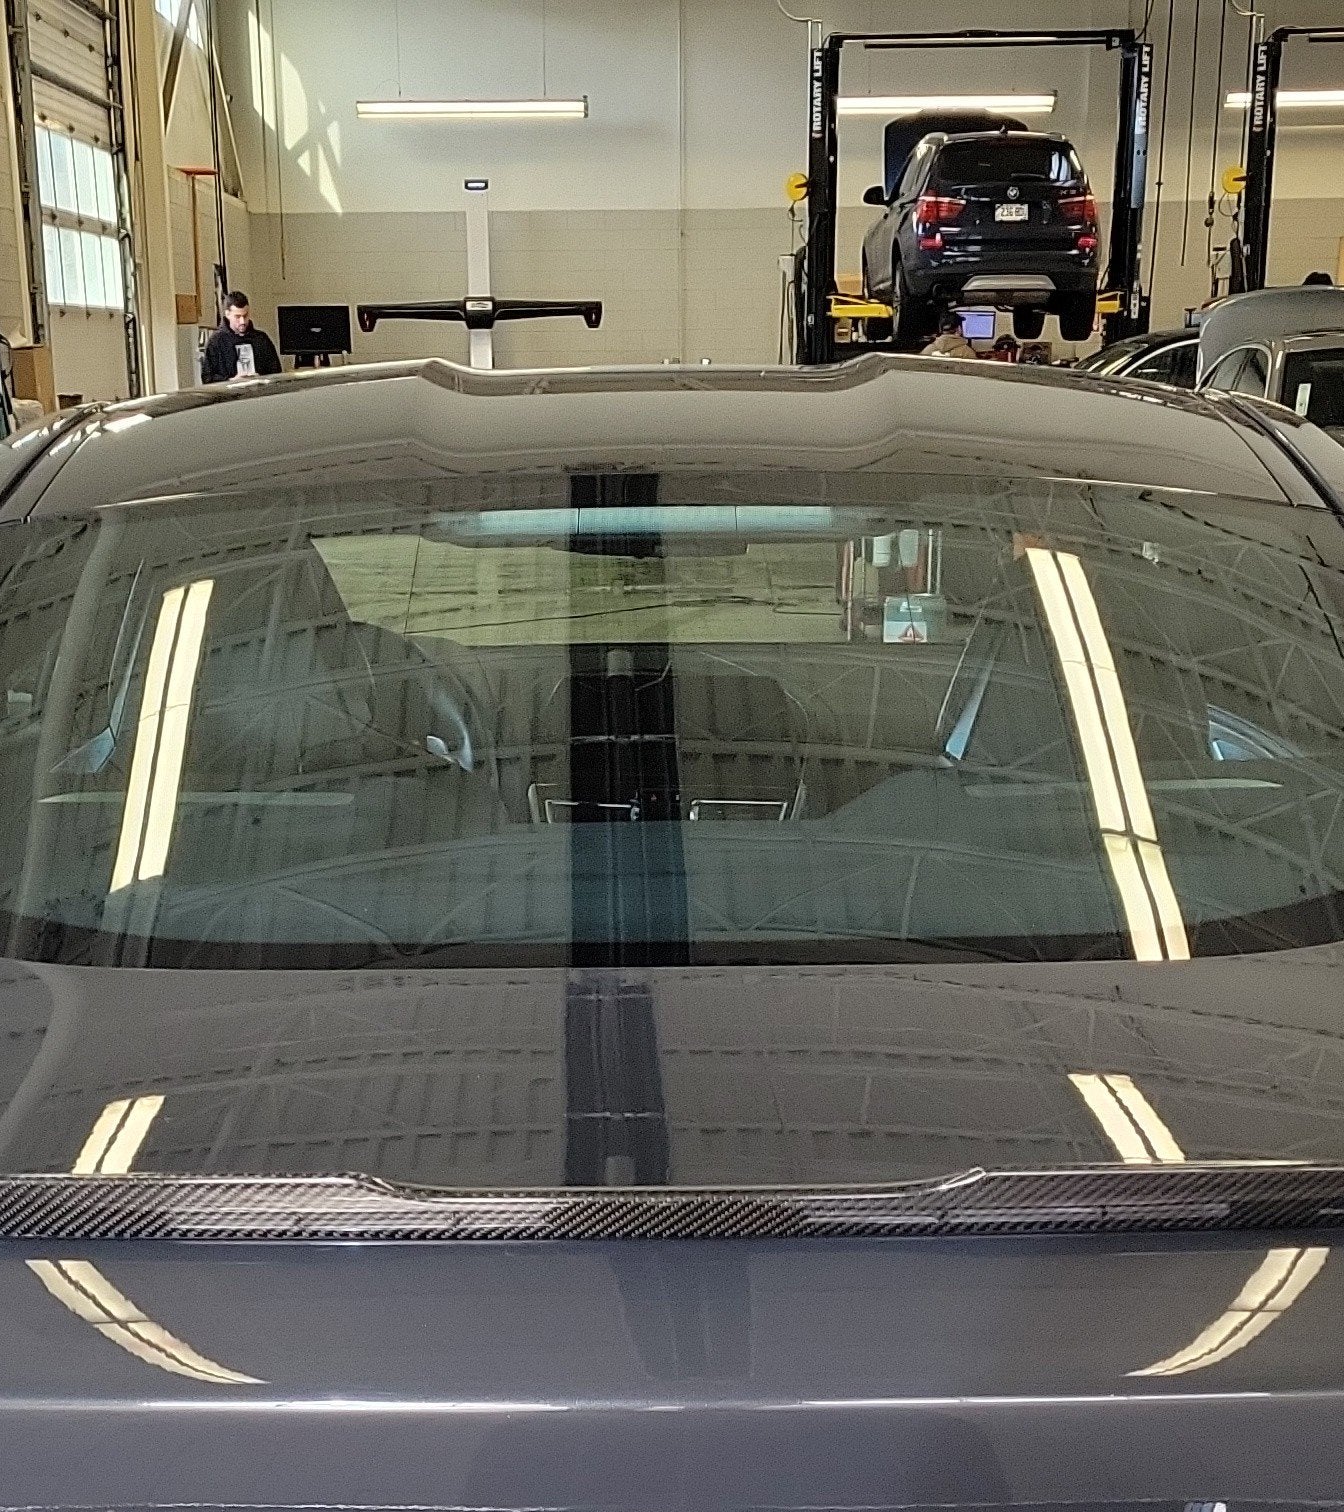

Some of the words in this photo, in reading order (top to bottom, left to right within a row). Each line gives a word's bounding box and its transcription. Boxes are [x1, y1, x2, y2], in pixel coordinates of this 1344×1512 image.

[813, 50, 822, 77] LIFT
[1142, 45, 1150, 72] LIFT
[1257, 44, 1268, 71] LIFT
[812, 80, 822, 131] ROTARY
[1254, 75, 1266, 125] ROTARY
